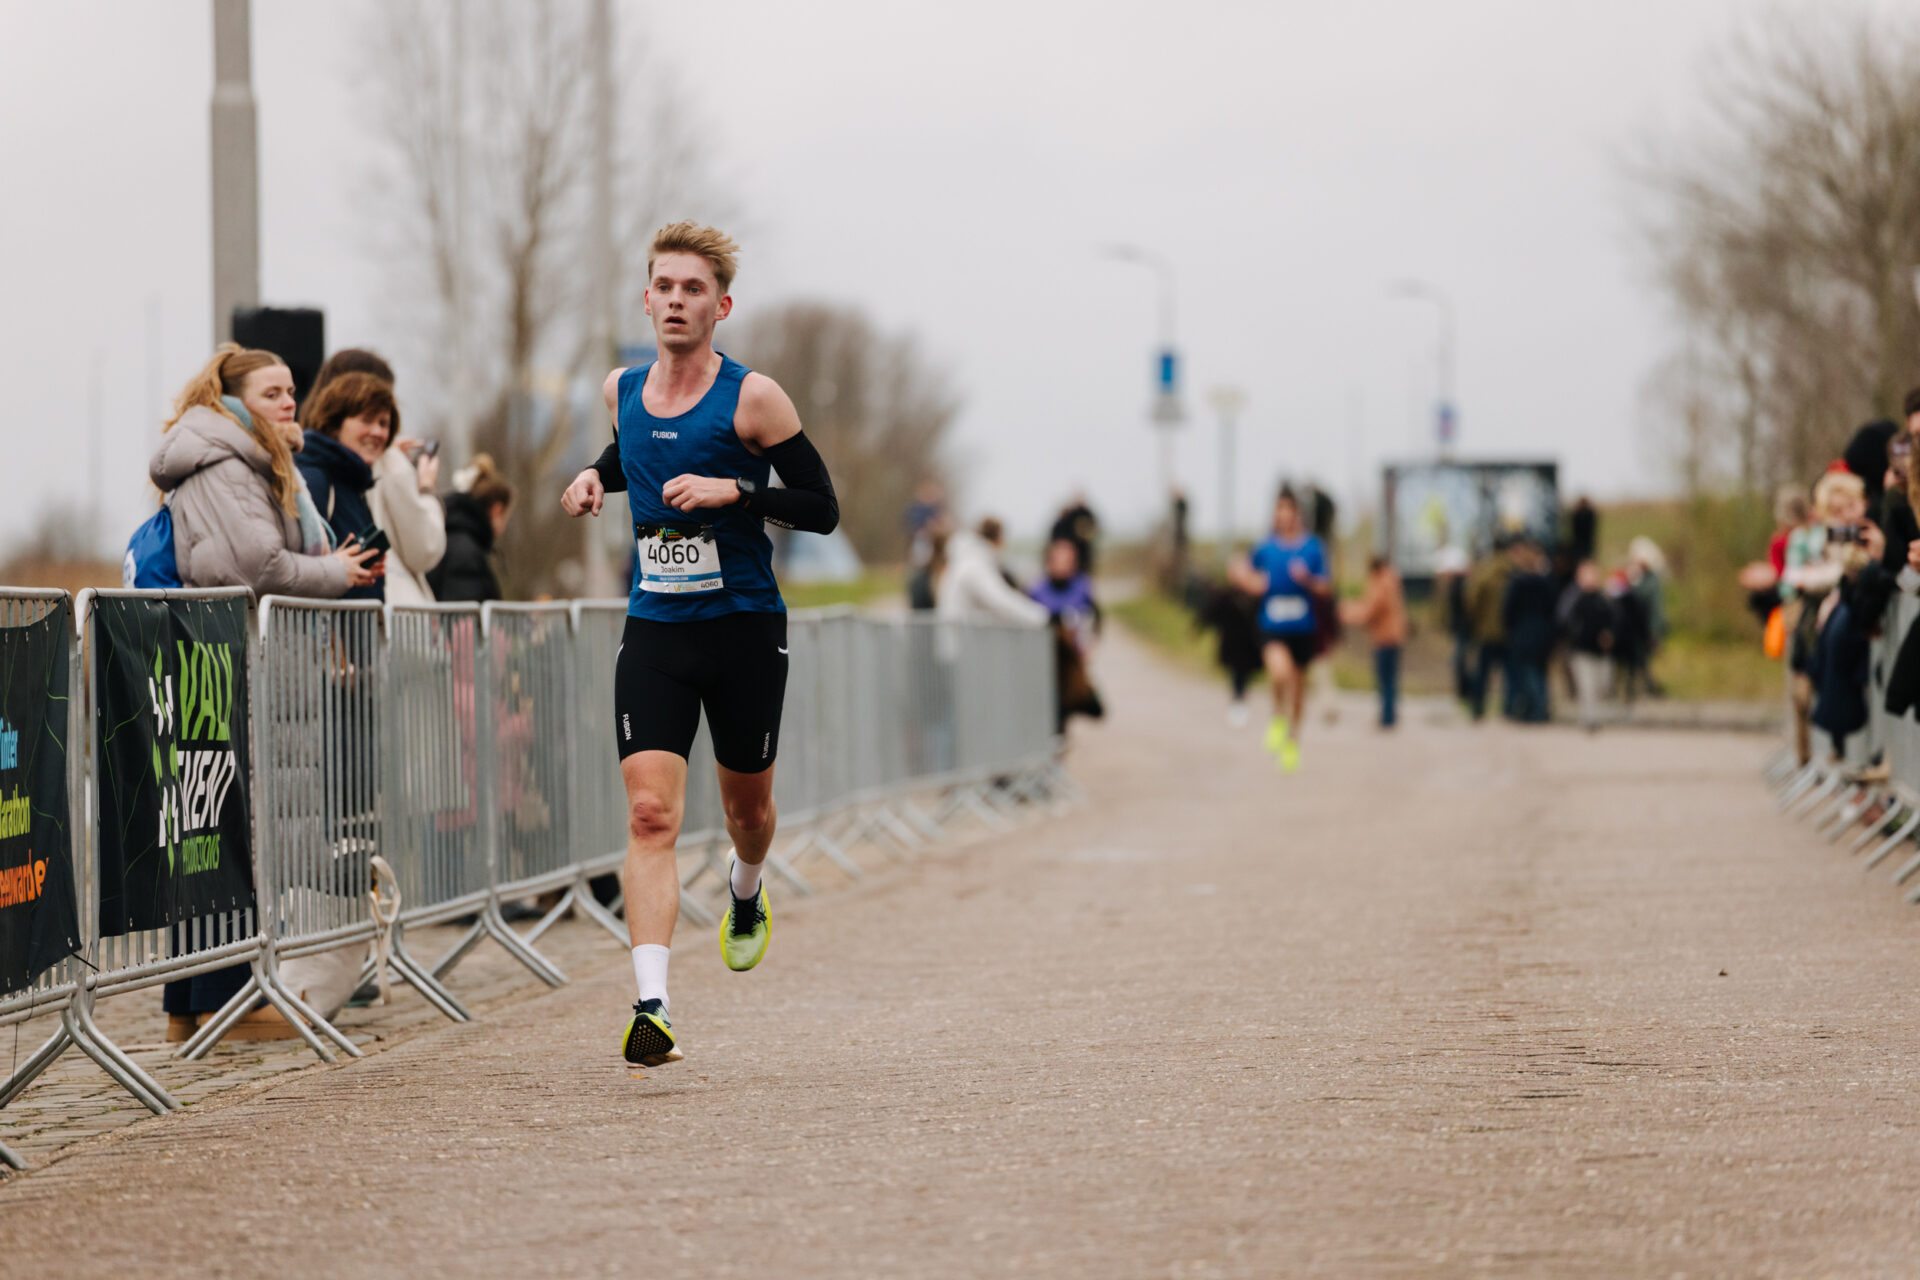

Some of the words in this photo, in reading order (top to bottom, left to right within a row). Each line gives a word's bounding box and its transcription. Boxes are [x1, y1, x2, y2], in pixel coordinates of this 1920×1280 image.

[652, 430, 678, 440] FUSION
[647, 544, 700, 564] 4060
[660, 566, 685, 574] Joakim
[701, 580, 719, 588] 4060
[622, 713, 632, 740] FUSION
[0, 717, 19, 771] inter
[0, 783, 31, 840] arathon
[0, 847, 50, 908] eeuwarde
